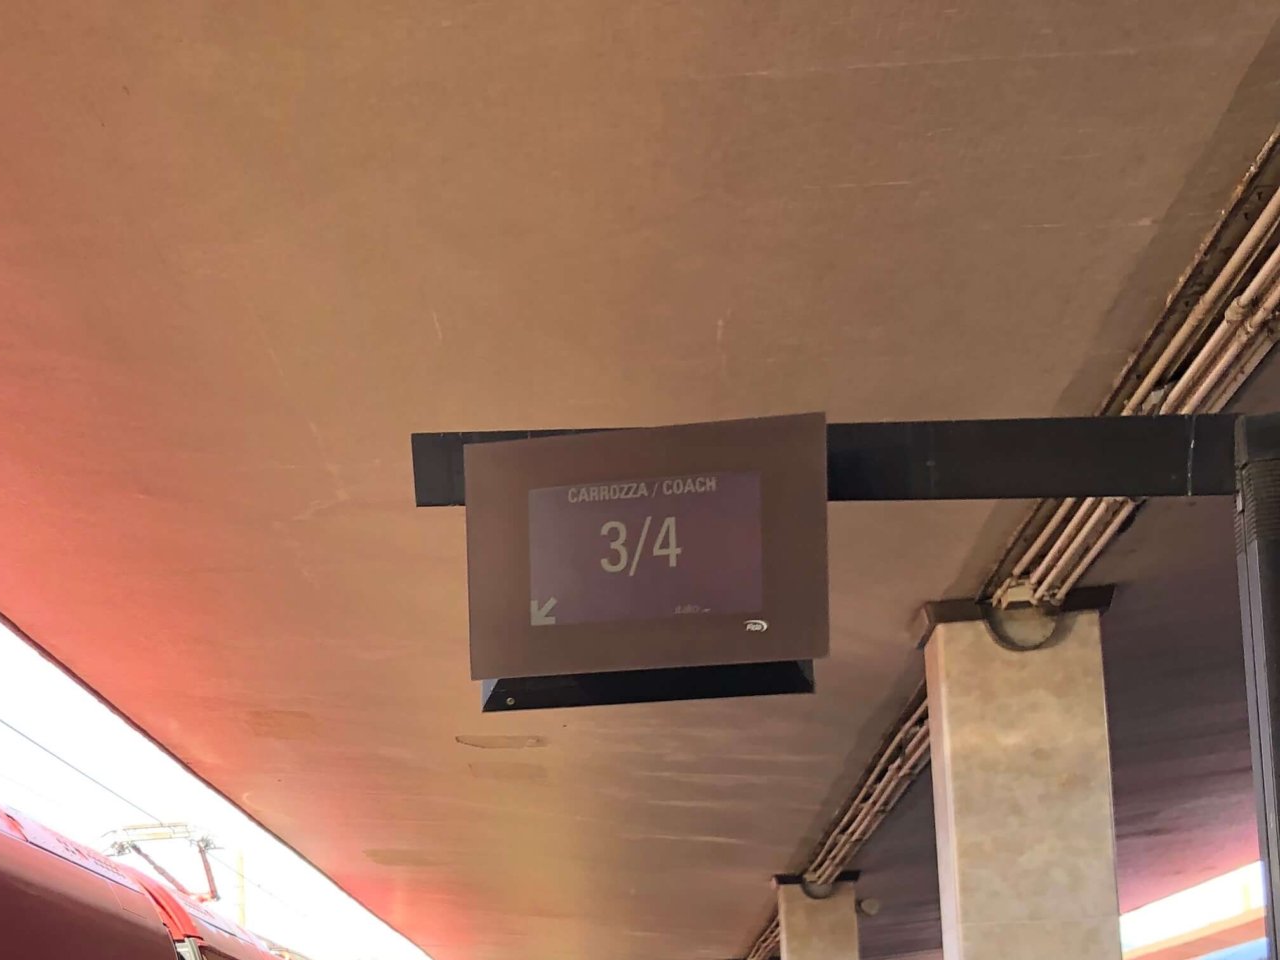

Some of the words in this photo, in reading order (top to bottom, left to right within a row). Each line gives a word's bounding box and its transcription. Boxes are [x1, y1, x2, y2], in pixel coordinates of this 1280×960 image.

[568, 482, 649, 503] CARROZZA
[651, 483, 660, 498] /
[662, 476, 718, 495] COACH
[600, 516, 683, 576] 3/4
